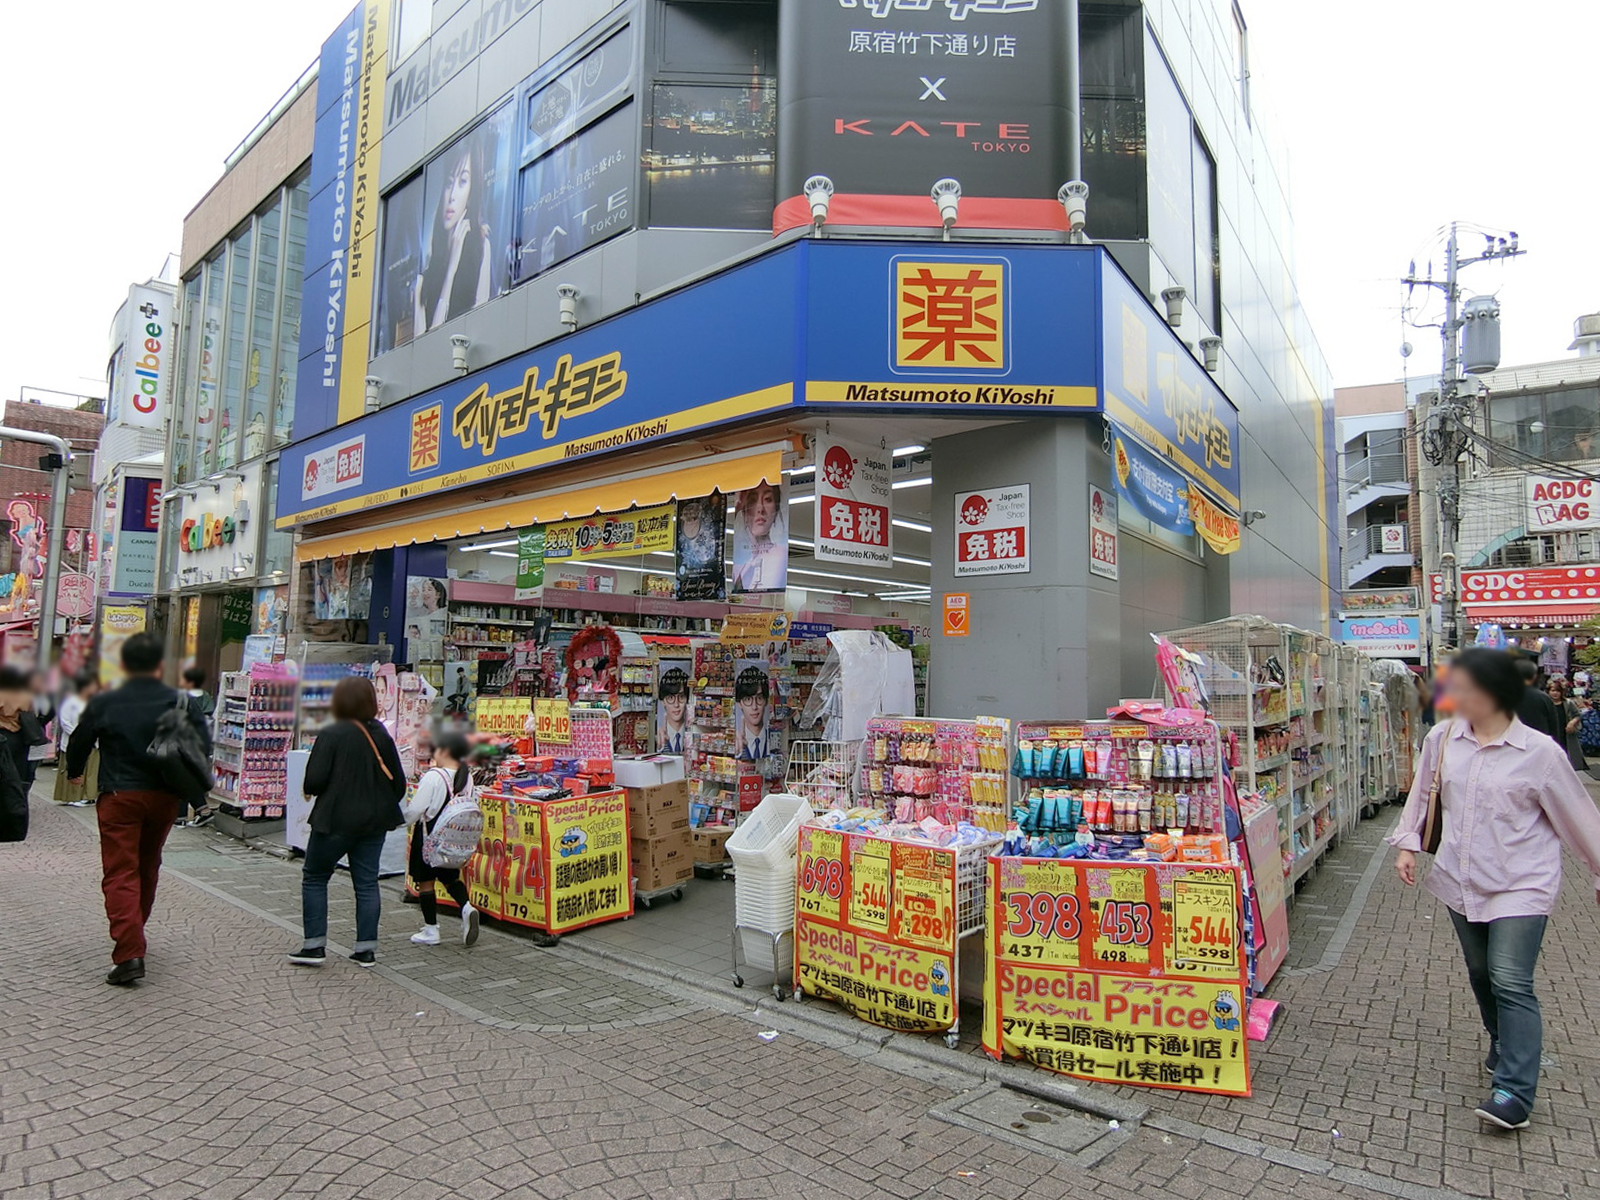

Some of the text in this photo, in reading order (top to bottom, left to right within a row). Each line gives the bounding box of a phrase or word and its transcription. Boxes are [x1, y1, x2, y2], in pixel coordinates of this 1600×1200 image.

[849, 30, 1016, 57] 原宿竹下通り店
[835, 119, 1030, 139] KATE
[351, 4, 378, 278] Matsumoto KiYoshi
[971, 141, 1031, 153] TOKYO
[323, 27, 359, 387] Matsumoto KiYoshi
[590, 208, 628, 235] TOKYO
[902, 268, 997, 362] 薬
[846, 385, 1055, 405] Matsumoto KiYoshi
[412, 410, 439, 468] 薬
[564, 419, 668, 458] Matsumoto KiYoshi
[338, 448, 362, 479] 免税
[487, 461, 515, 476] SOFINA
[440, 473, 467, 488] Kanebo
[860, 470, 889, 485] Tax-free
[870, 484, 889, 497] Shop
[1533, 479, 1592, 501] ACDC
[996, 502, 1026, 512] Tax-free
[1006, 511, 1026, 520] Shop
[1536, 503, 1589, 525] RAG
[829, 502, 881, 544] 免税
[820, 545, 889, 562] Matsumoto KiYoshi
[966, 530, 1017, 561] 免税
[1094, 532, 1114, 564] 免税
[958, 562, 1026, 574] Matsumoto KiYoshi
[1461, 573, 1526, 591] CDC
[1396, 643, 1416, 651] VIP
[538, 716, 551, 732] 119
[555, 717, 569, 733] 119
[547, 800, 623, 818] Special Price
[803, 854, 844, 899] 698
[475, 891, 489, 909] 128
[800, 897, 820, 911] 767
[862, 882, 886, 910] 544
[1177, 894, 1231, 907] ユースキンA
[510, 903, 528, 919] 79
[866, 909, 885, 920] 598
[1008, 890, 1082, 940] 398
[911, 914, 943, 939] 298
[1100, 899, 1153, 946] 453
[1190, 916, 1231, 947] 544
[800, 920, 929, 992] Special Price
[1009, 944, 1044, 958] 437
[1101, 949, 1127, 963] 498
[1198, 947, 1230, 959] 598
[808, 950, 854, 974] スペシャル
[1001, 964, 1209, 1030] Special Price
[1112, 979, 1198, 999] プライス
[1013, 999, 1093, 1022] スペシャル
